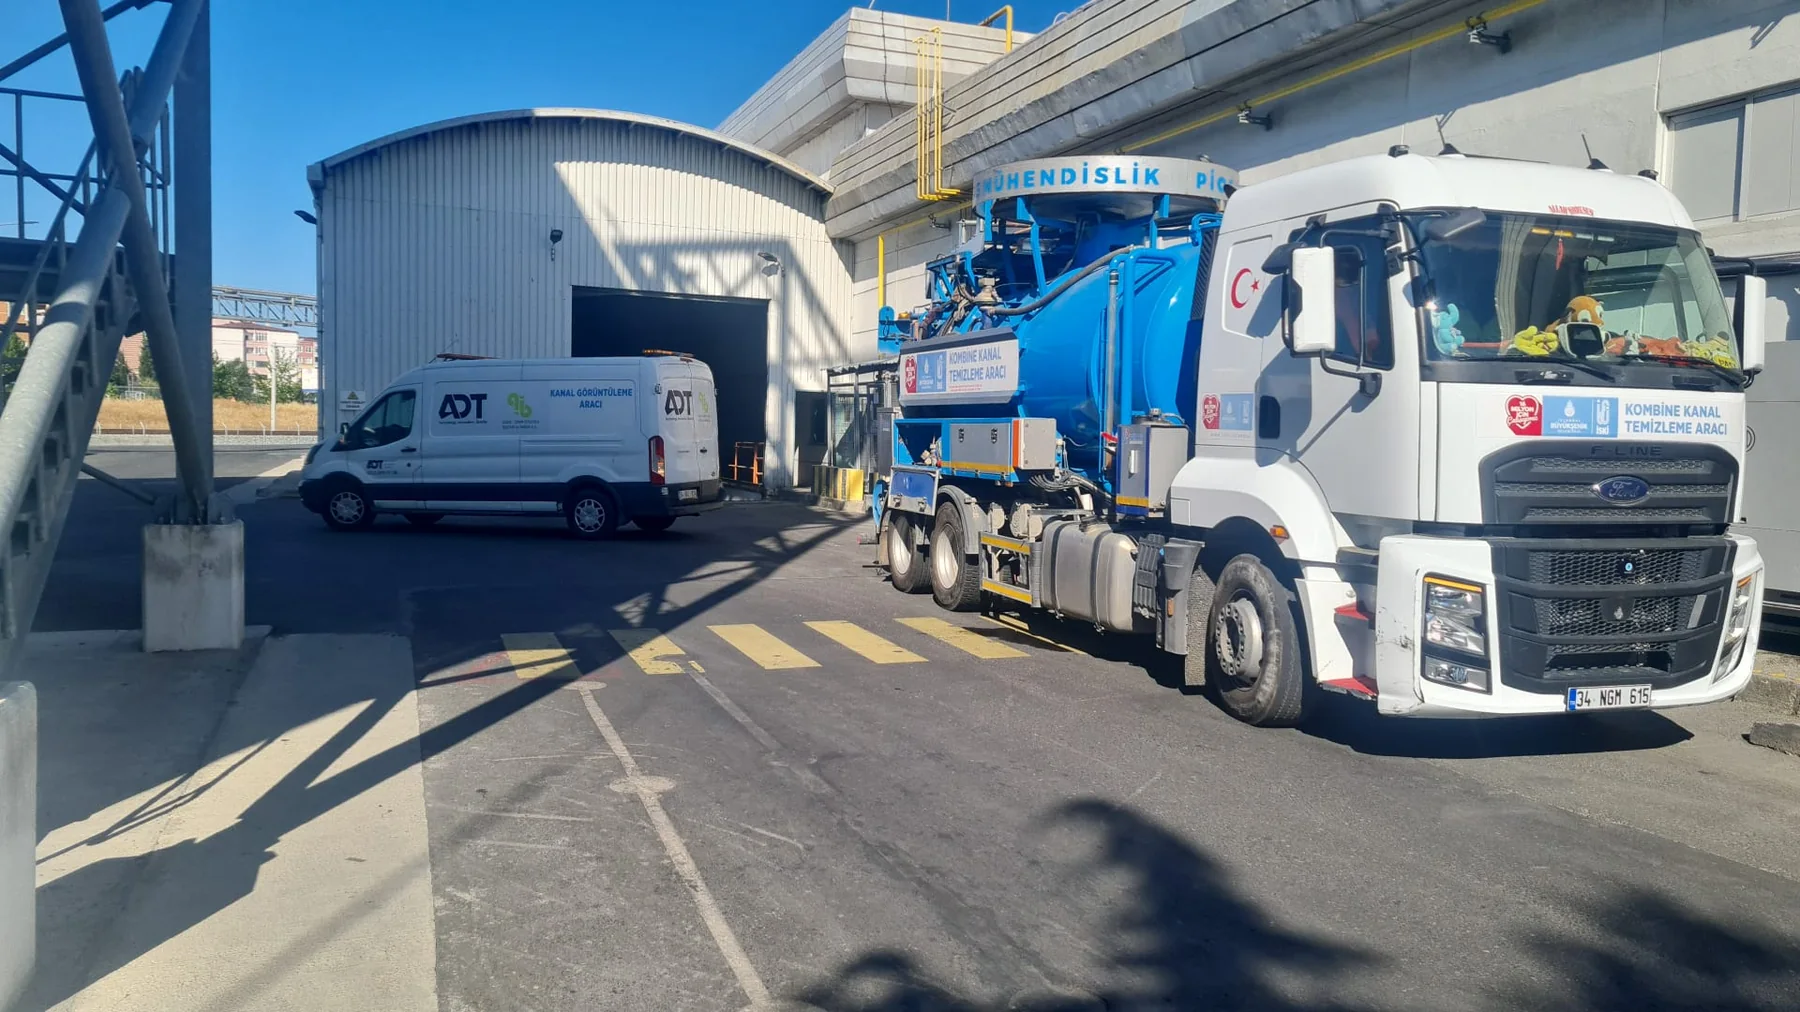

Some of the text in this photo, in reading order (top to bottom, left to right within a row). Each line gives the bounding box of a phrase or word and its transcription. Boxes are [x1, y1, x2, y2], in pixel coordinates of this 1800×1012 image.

[949, 346, 1001, 365] KOMBİNE KANAL
[949, 365, 1006, 382] TEMİZLEME ARACI
[550, 387, 633, 397] KANAL GÖRÜNTÜLEME
[438, 393, 487, 419] ADT
[579, 400, 602, 409] ARACI
[665, 390, 692, 415] ADT
[1625, 402, 1721, 418] KOMBİNE KANAL
[1625, 418, 1727, 435] TEMİZLEME ARACI
[1591, 446, 1662, 456] F-LINE
[1609, 481, 1640, 497] Ford
[1577, 688, 1649, 707] 34 NGM 615
